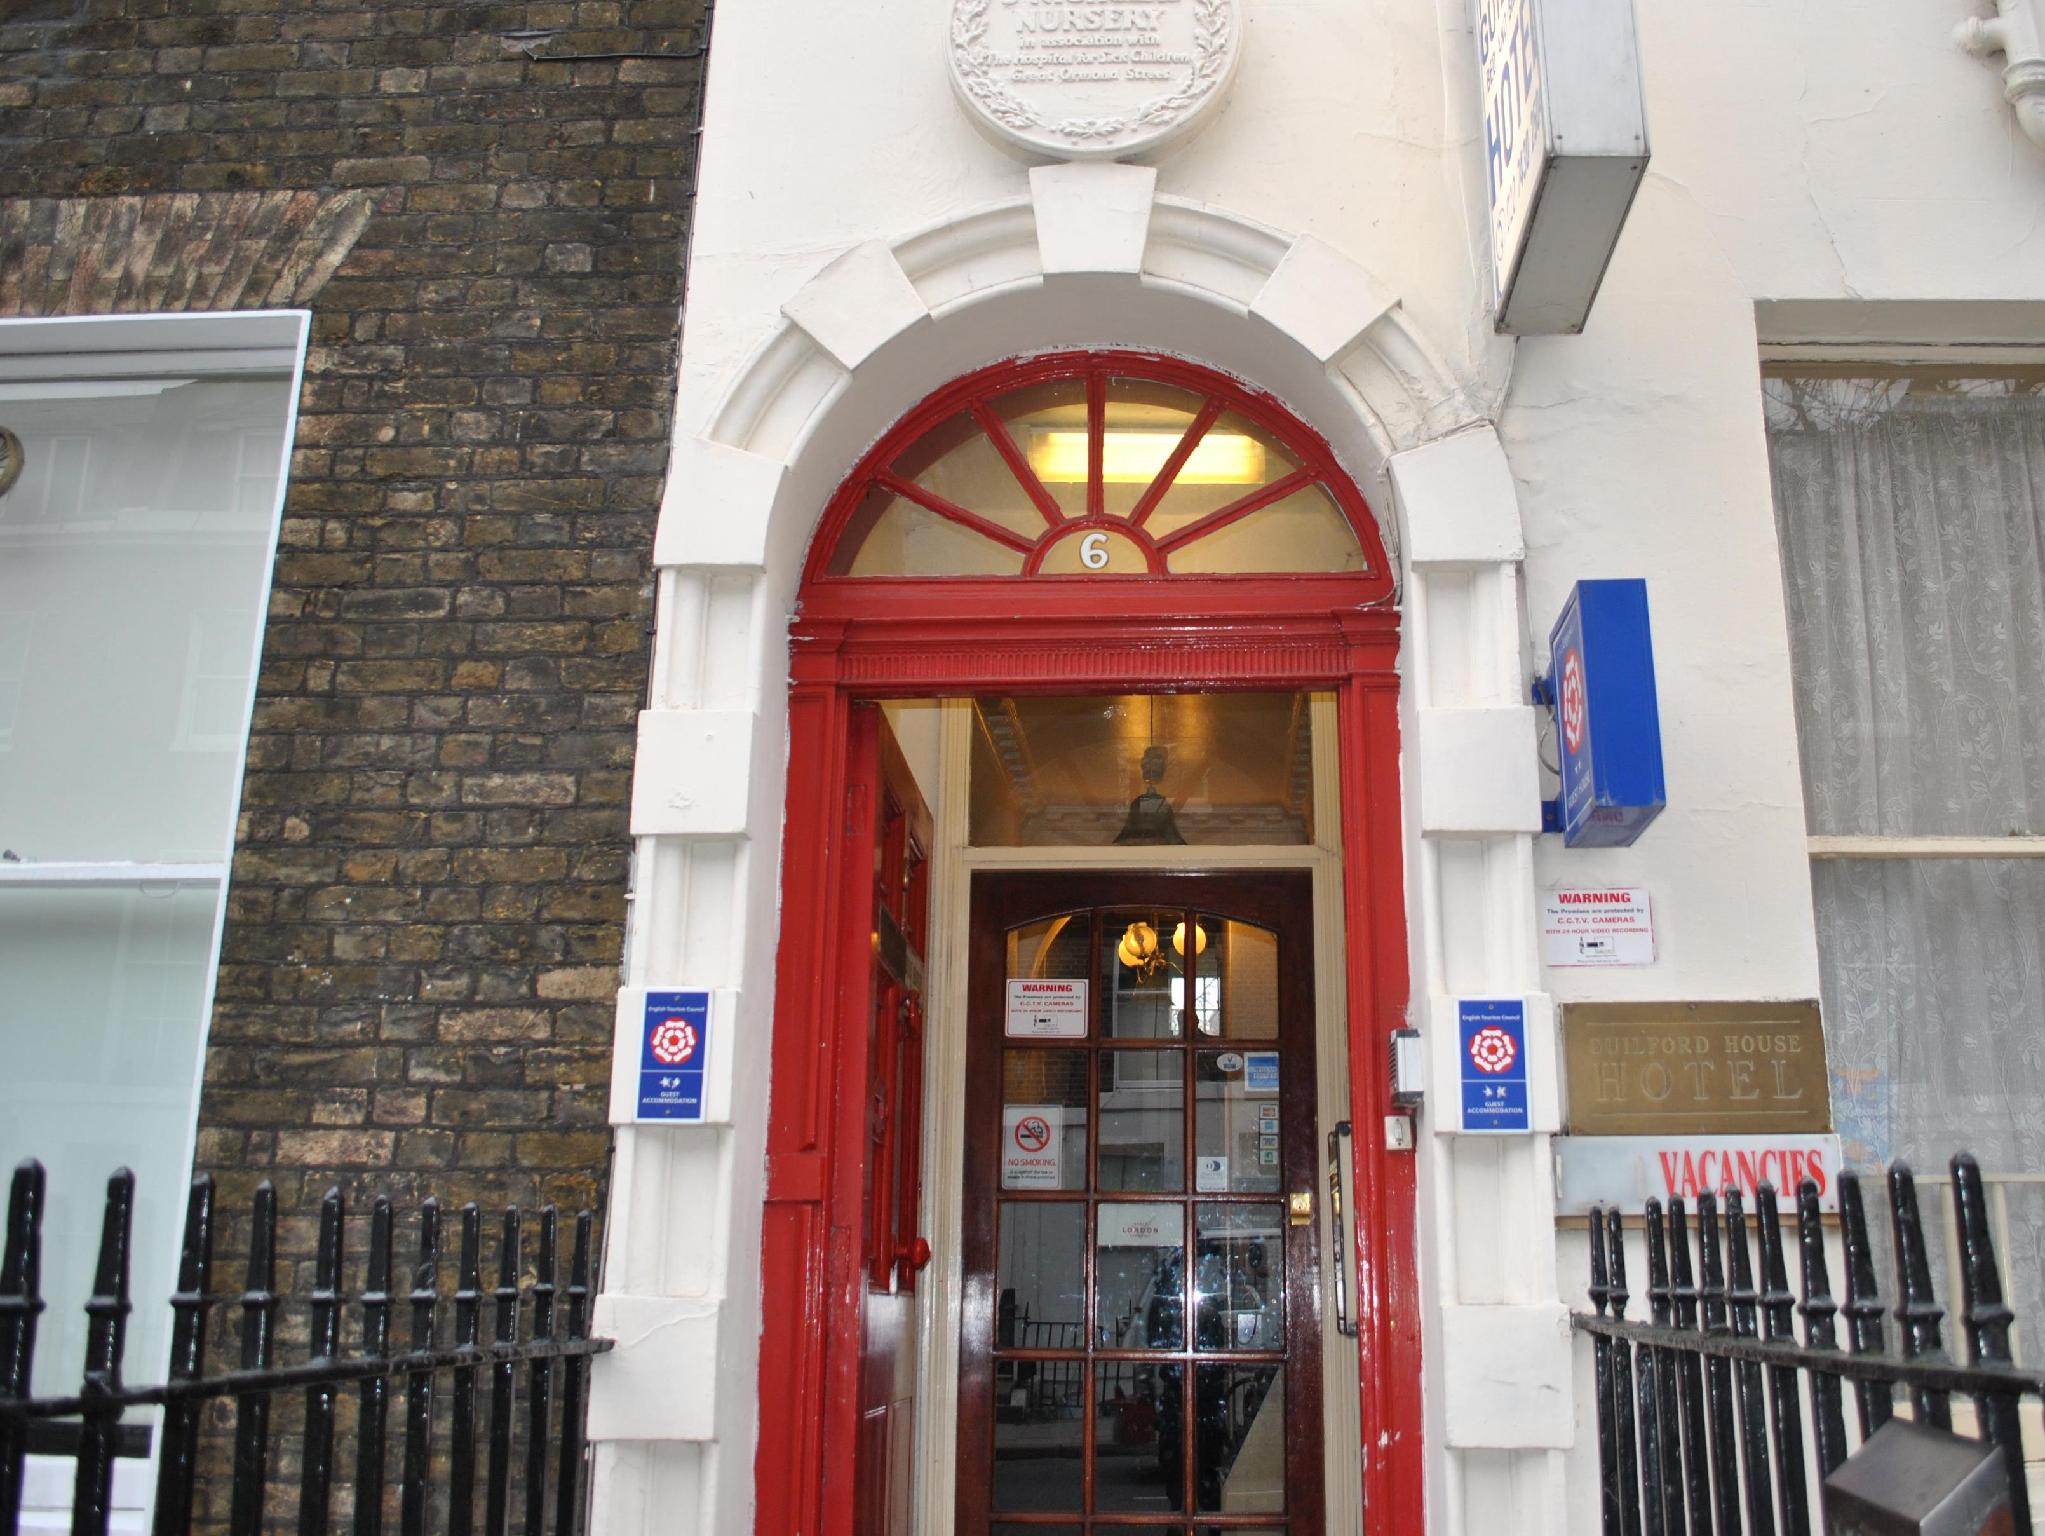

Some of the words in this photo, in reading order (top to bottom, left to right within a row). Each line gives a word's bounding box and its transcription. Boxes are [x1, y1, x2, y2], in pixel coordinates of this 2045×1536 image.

[1016, 8, 1167, 33] NURSERY
[1019, 36, 1035, 50] in
[1041, 35, 1123, 49] association
[1126, 34, 1161, 47] with
[1080, 532, 1109, 569] 6
[1558, 892, 1632, 904] WARNING
[1022, 984, 1073, 992] WARNING
[1590, 1036, 1710, 1055] GUILFORD
[1724, 1035, 1801, 1053] HOUSE
[1594, 1059, 1803, 1102] HOTEL
[1008, 1159, 1019, 1167] NO
[1020, 1159, 1056, 1167] SMOKING
[1658, 1149, 1827, 1198] VACANCIES
